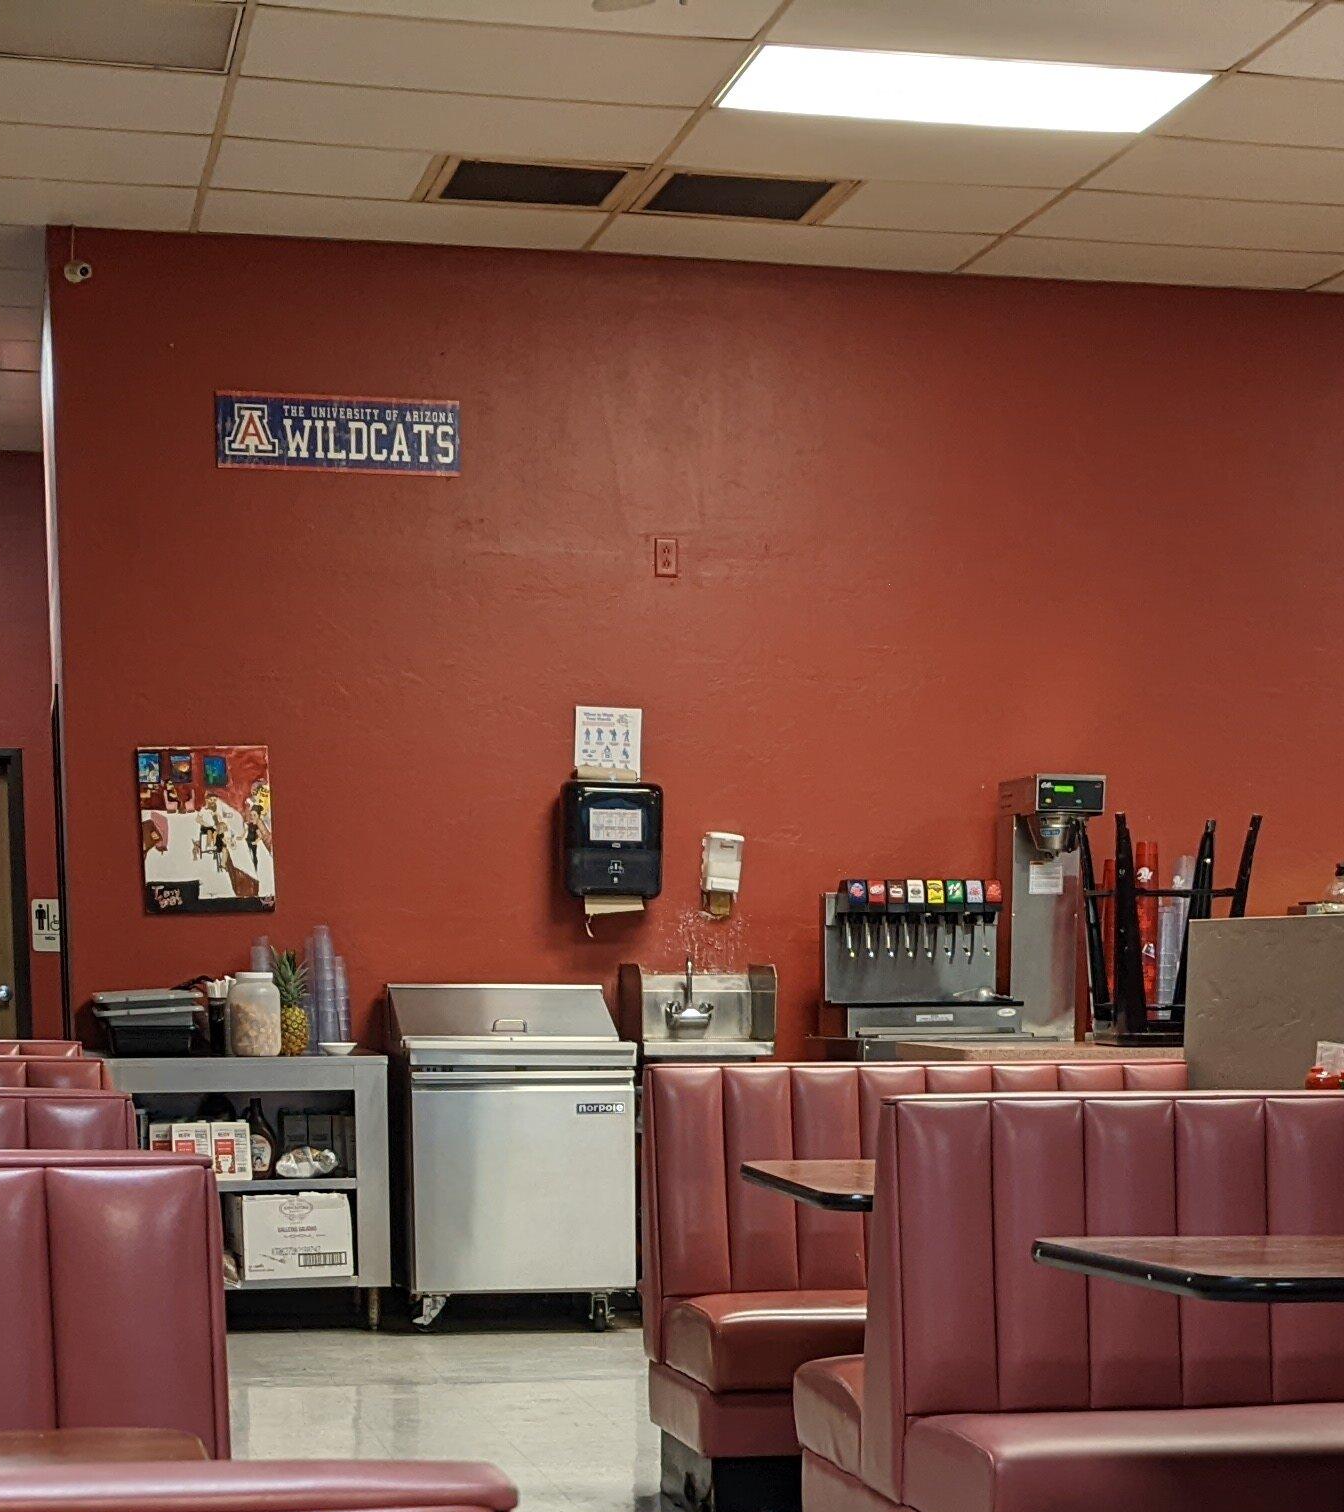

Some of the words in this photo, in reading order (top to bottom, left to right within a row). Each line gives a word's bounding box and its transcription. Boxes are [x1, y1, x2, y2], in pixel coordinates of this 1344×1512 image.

[282, 404, 305, 417] THE
[310, 406, 380, 421] UNIVERSITY
[385, 409, 399, 421] OF
[405, 410, 454, 423] ARIZONA
[282, 418, 454, 464] WILDCATS
[578, 1103, 624, 1113] norpole
